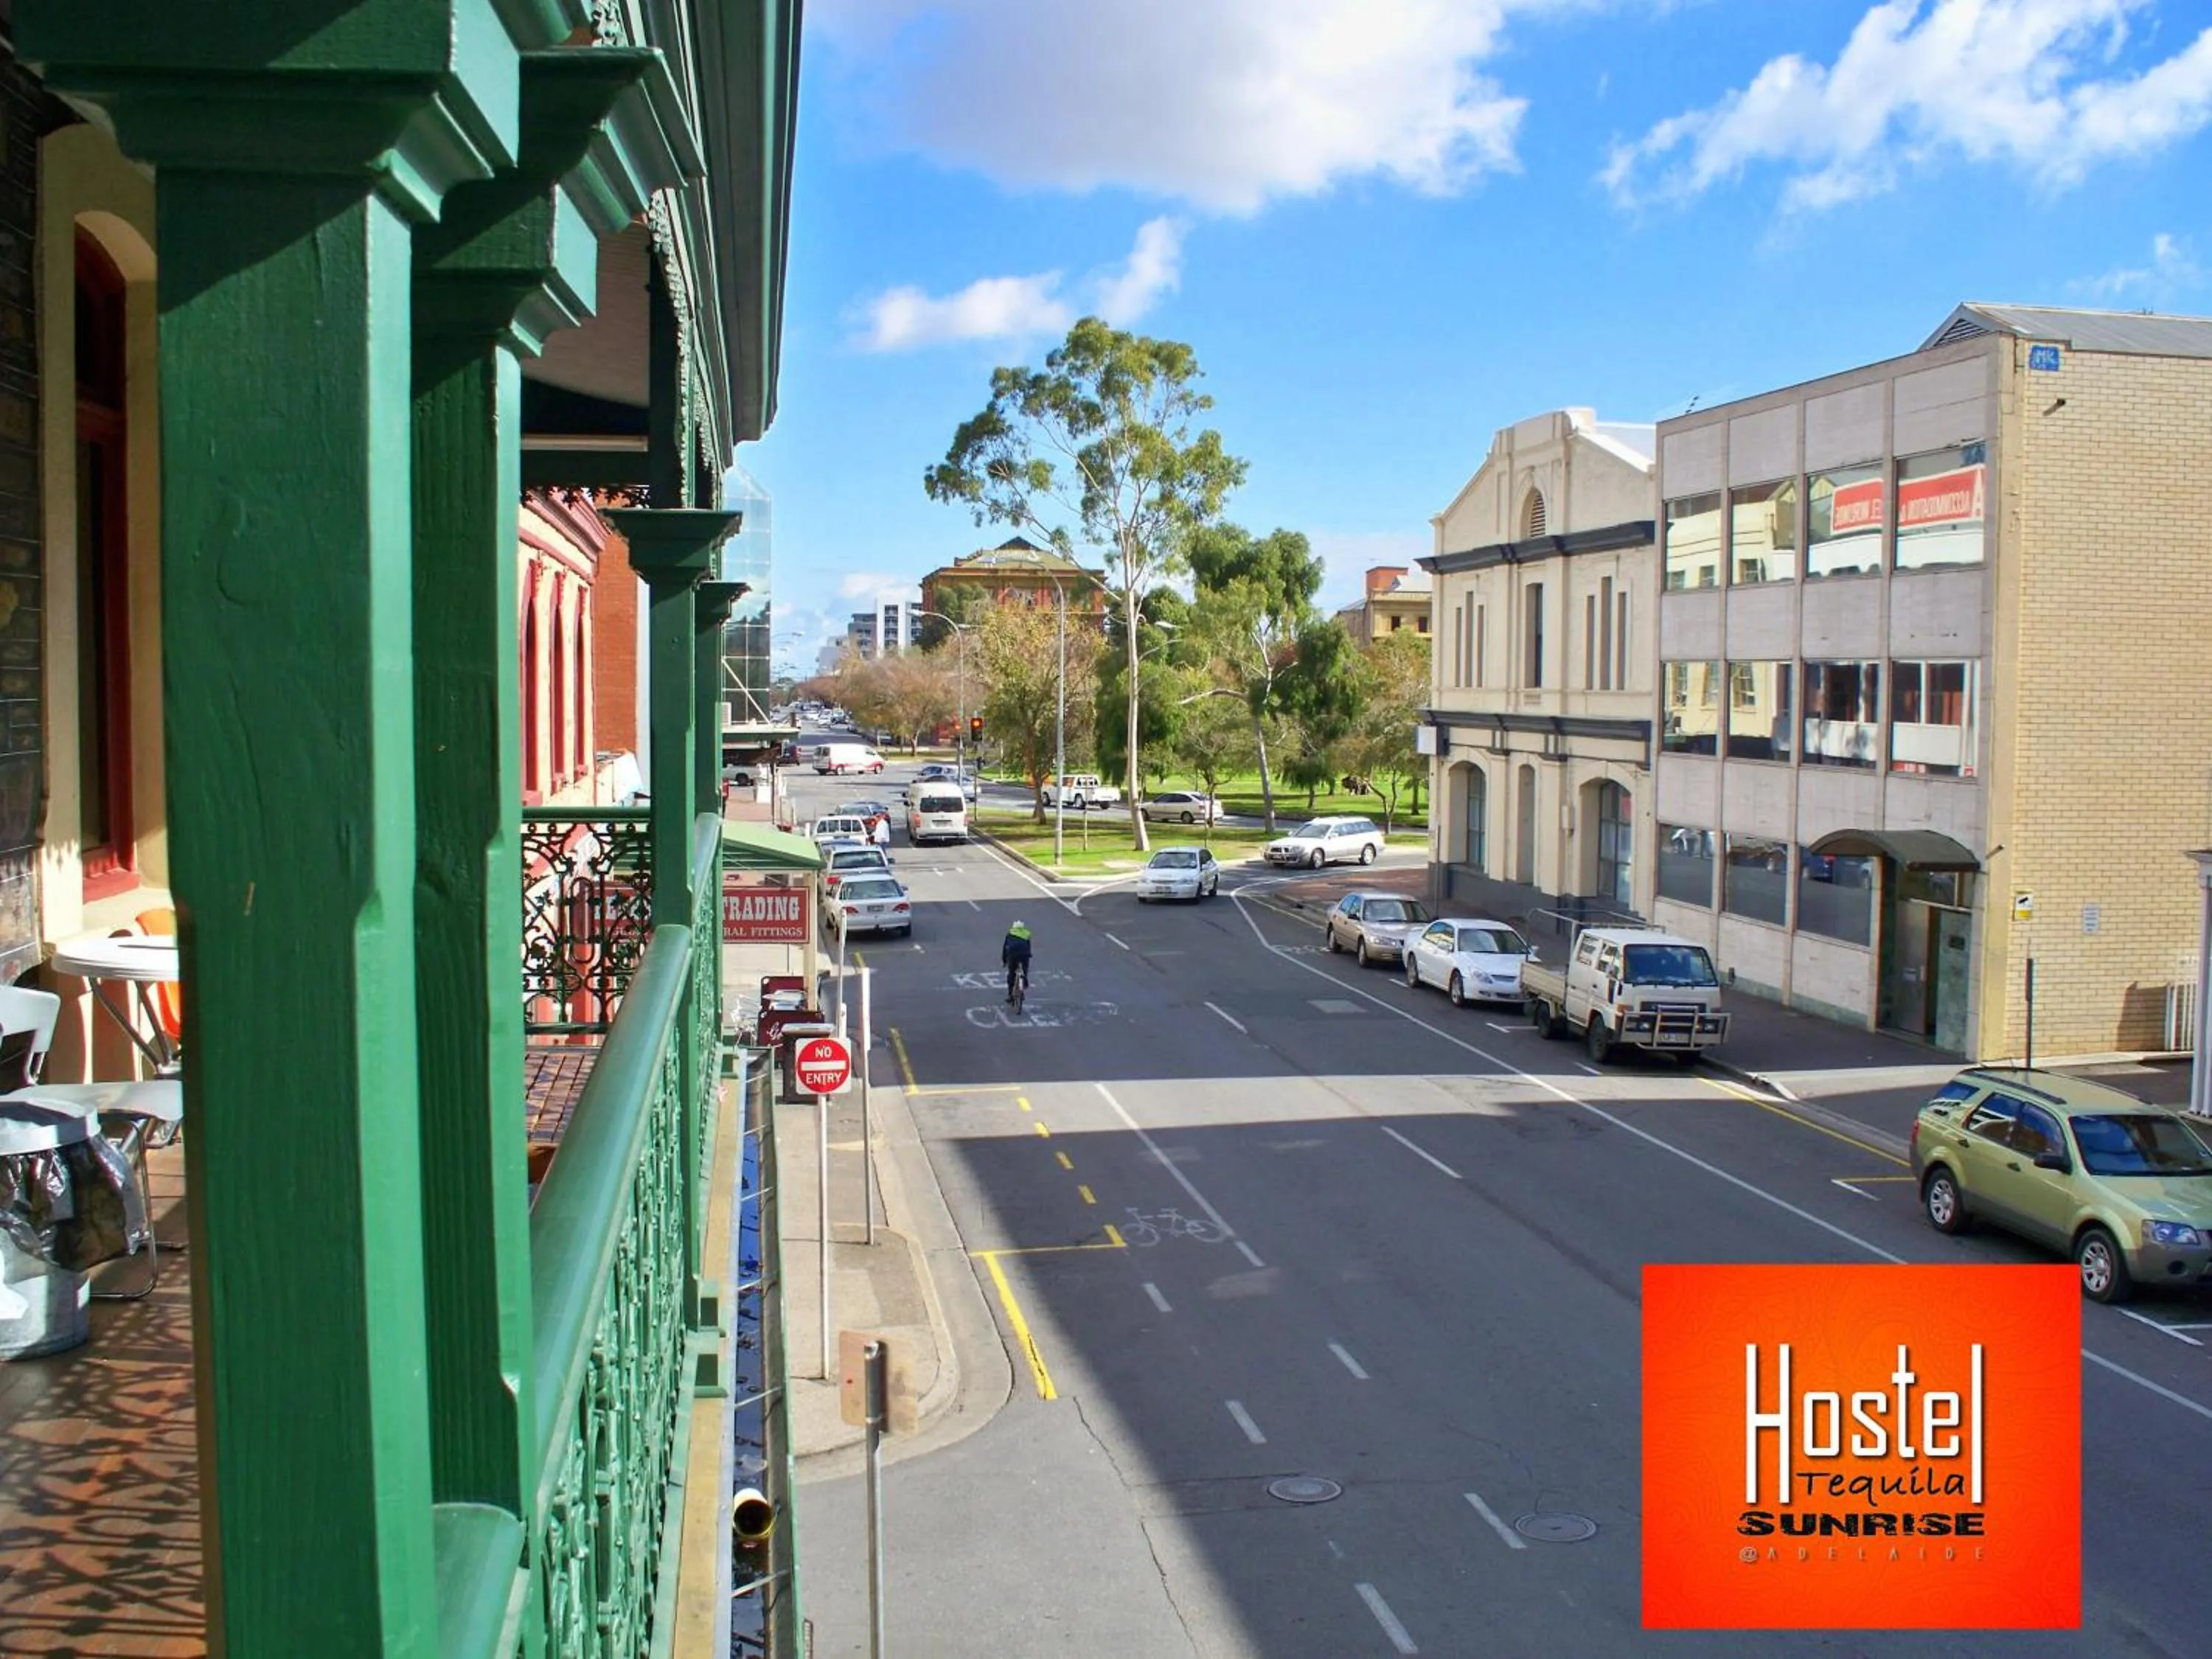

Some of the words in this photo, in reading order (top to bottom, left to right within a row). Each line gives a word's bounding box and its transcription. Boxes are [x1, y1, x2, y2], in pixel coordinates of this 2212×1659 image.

[750, 927, 803, 936] FITTINGS
[815, 1046, 832, 1058] NO
[806, 1072, 842, 1085] ENTRY
